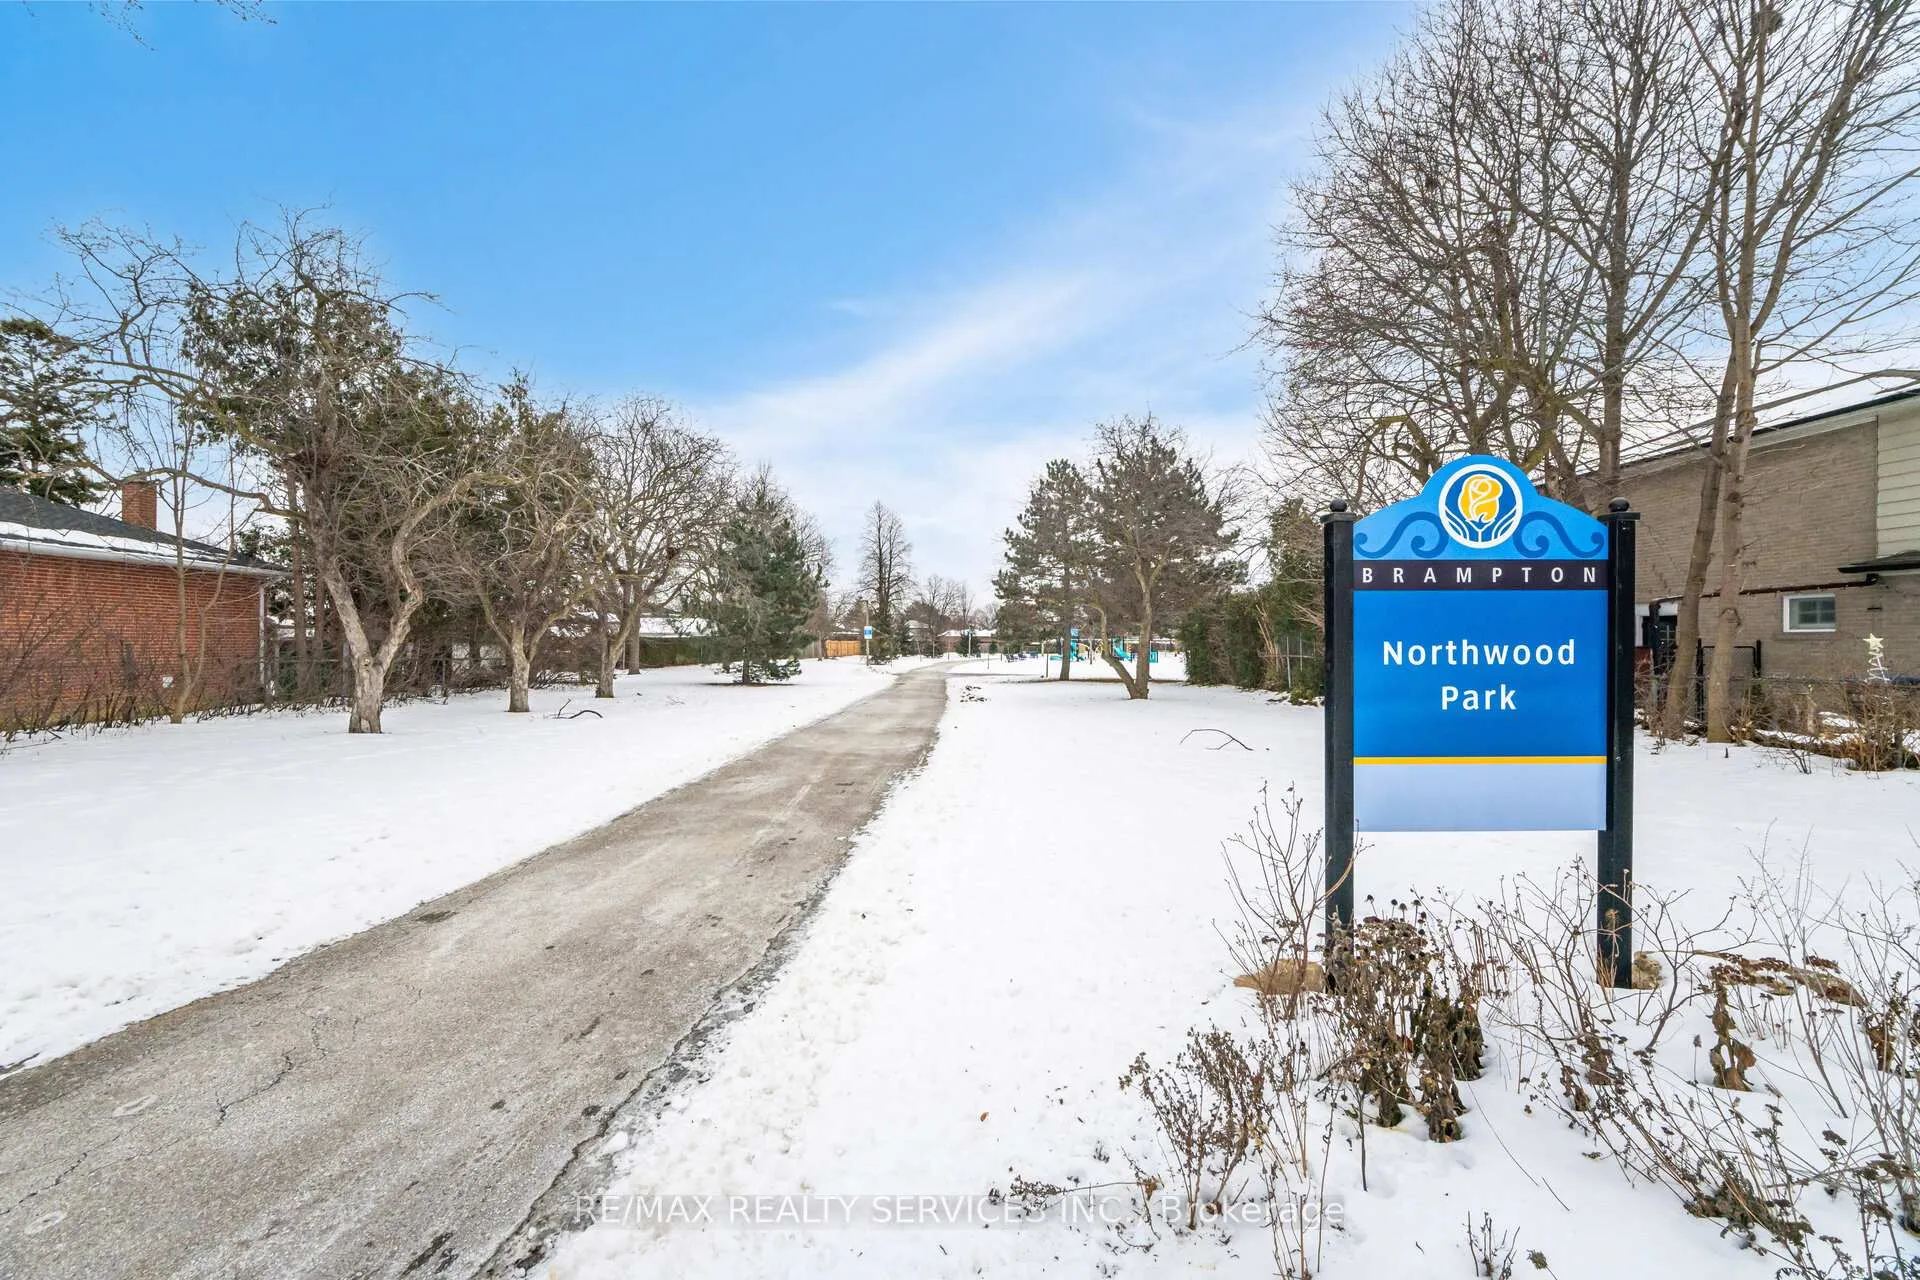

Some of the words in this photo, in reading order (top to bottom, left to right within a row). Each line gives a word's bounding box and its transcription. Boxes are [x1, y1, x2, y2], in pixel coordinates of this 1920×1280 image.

[1362, 567, 1597, 583] BRAMPTON
[1383, 639, 1575, 665] Northwood
[1441, 684, 1517, 711] Park
